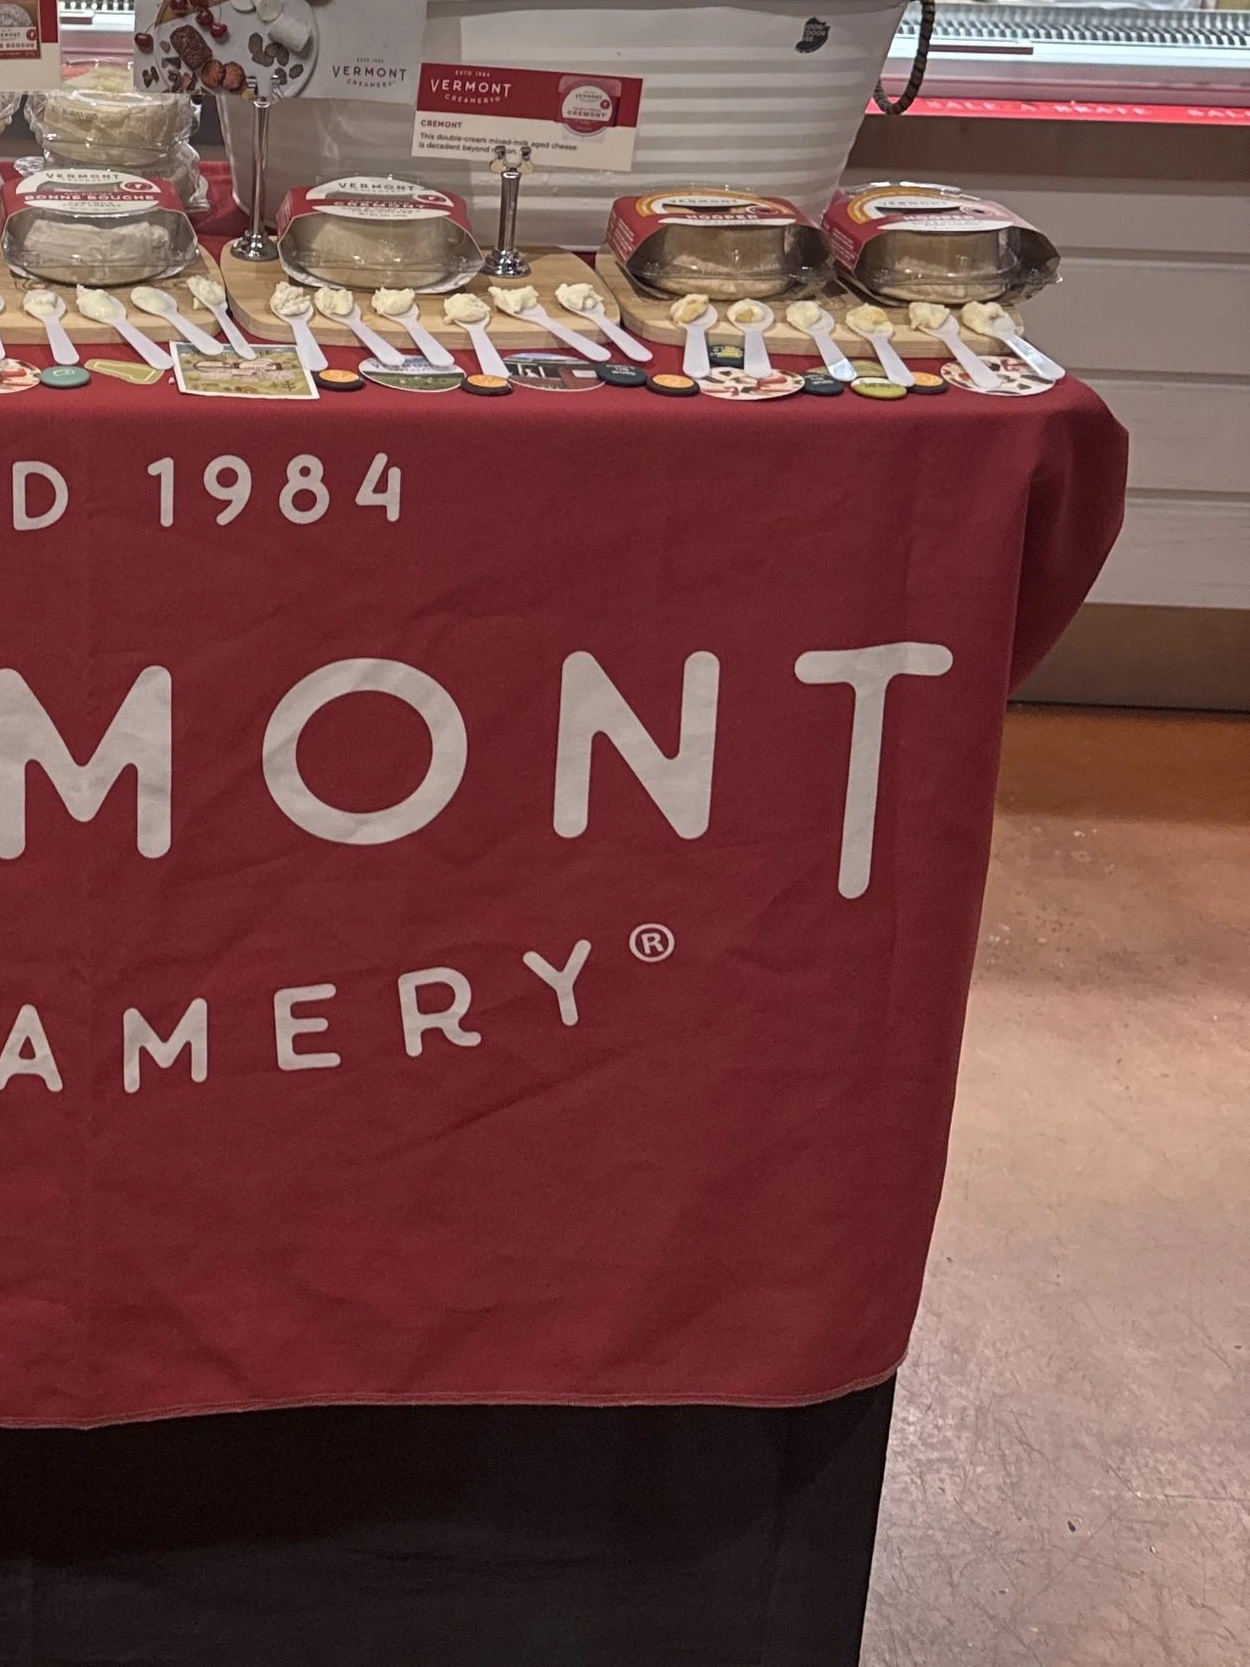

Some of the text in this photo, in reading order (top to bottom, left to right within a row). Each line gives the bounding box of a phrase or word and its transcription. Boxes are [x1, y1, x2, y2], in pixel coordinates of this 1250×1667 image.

[332, 65, 407, 80] VERMONT
[430, 78, 512, 98] VERMONT
[420, 119, 462, 130] CREMONT
[420, 132, 577, 152] This double-cream mixed-milk aged cheese
[426, 142, 460, 152] decadent
[462, 144, 491, 156] beyond
[46, 172, 119, 180] VERMONT
[338, 182, 416, 192] VERMONT
[147, 452, 402, 527] 1984
